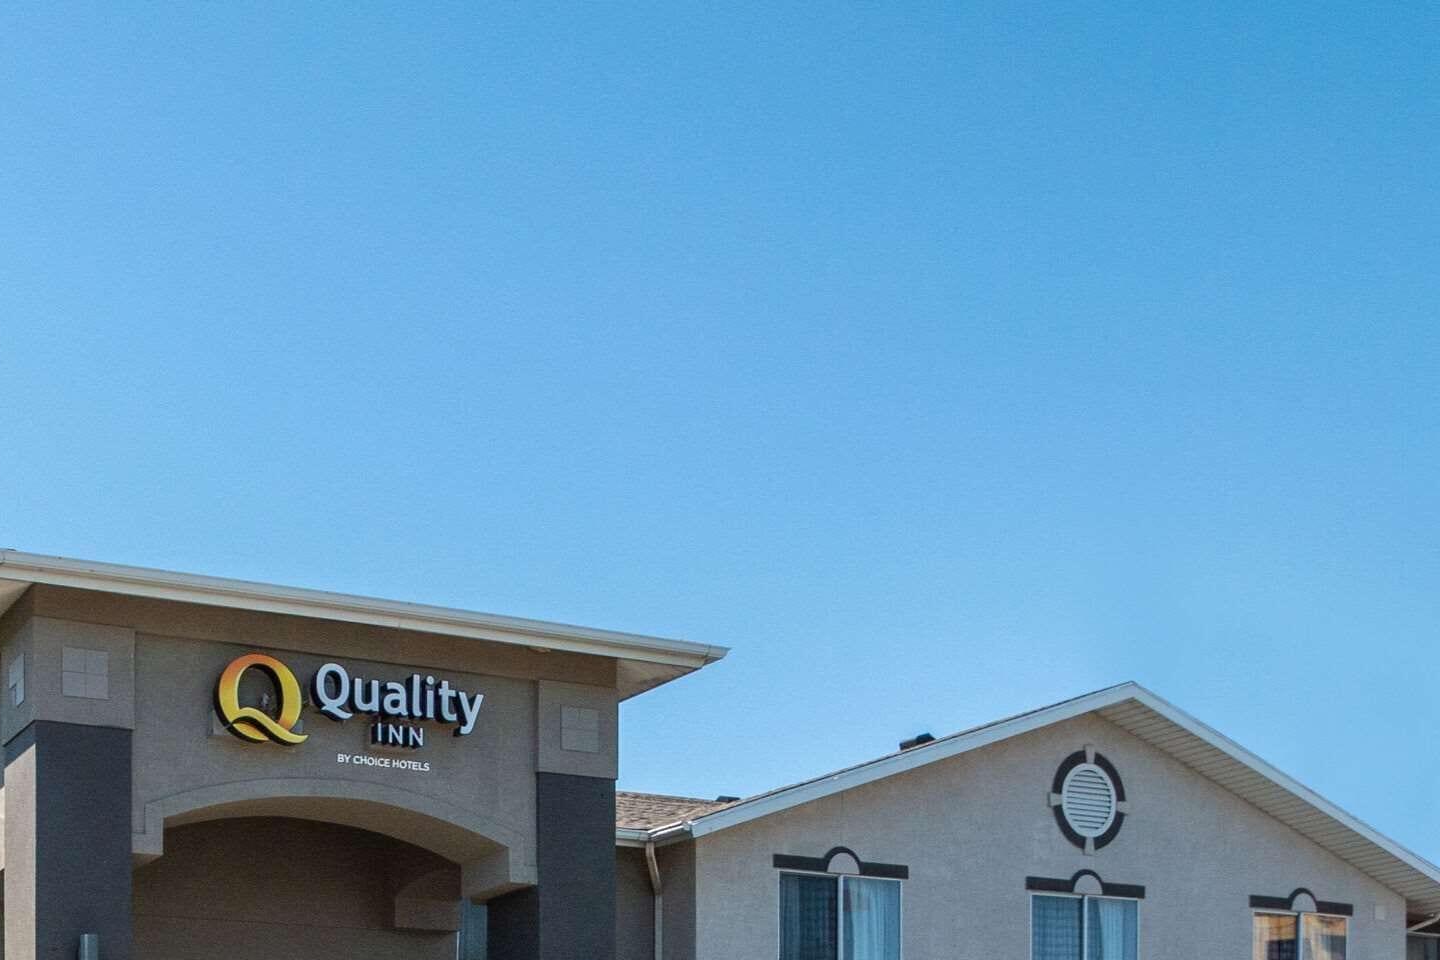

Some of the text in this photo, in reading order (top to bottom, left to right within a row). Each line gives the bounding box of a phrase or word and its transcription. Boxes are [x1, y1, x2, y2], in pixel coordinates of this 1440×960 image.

[216, 653, 309, 744] Q
[315, 662, 484, 734] Quality
[376, 722, 424, 747] INN
[337, 753, 430, 772] BY CHOICE HOTELS
